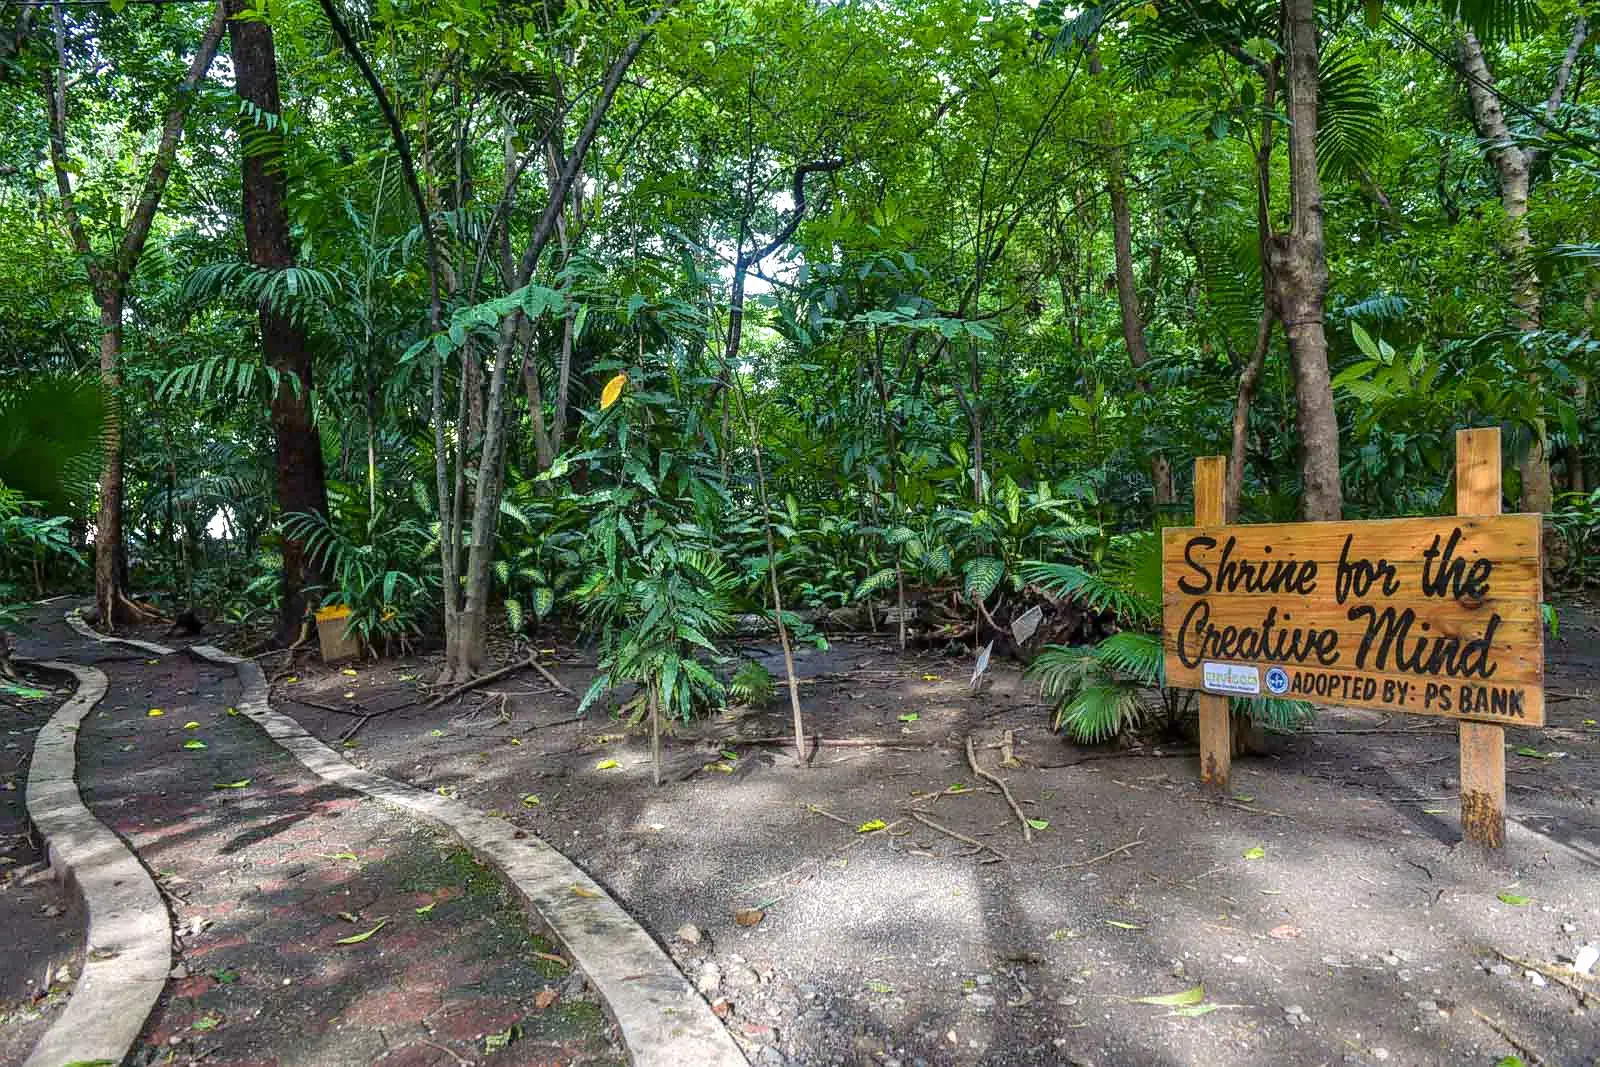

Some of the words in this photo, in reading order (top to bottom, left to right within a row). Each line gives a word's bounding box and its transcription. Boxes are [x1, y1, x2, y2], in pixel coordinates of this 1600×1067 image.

[1177, 535, 1318, 596] Shrine
[1335, 533, 1400, 605] for
[1421, 527, 1493, 600] the
[1177, 599, 1340, 669] Creative
[1347, 605, 1503, 678] Mind
[1291, 671, 1377, 701] ADOPTED
[1382, 679, 1416, 705] BY:
[1424, 686, 1453, 711] PS
[1458, 686, 1526, 718] BANK
